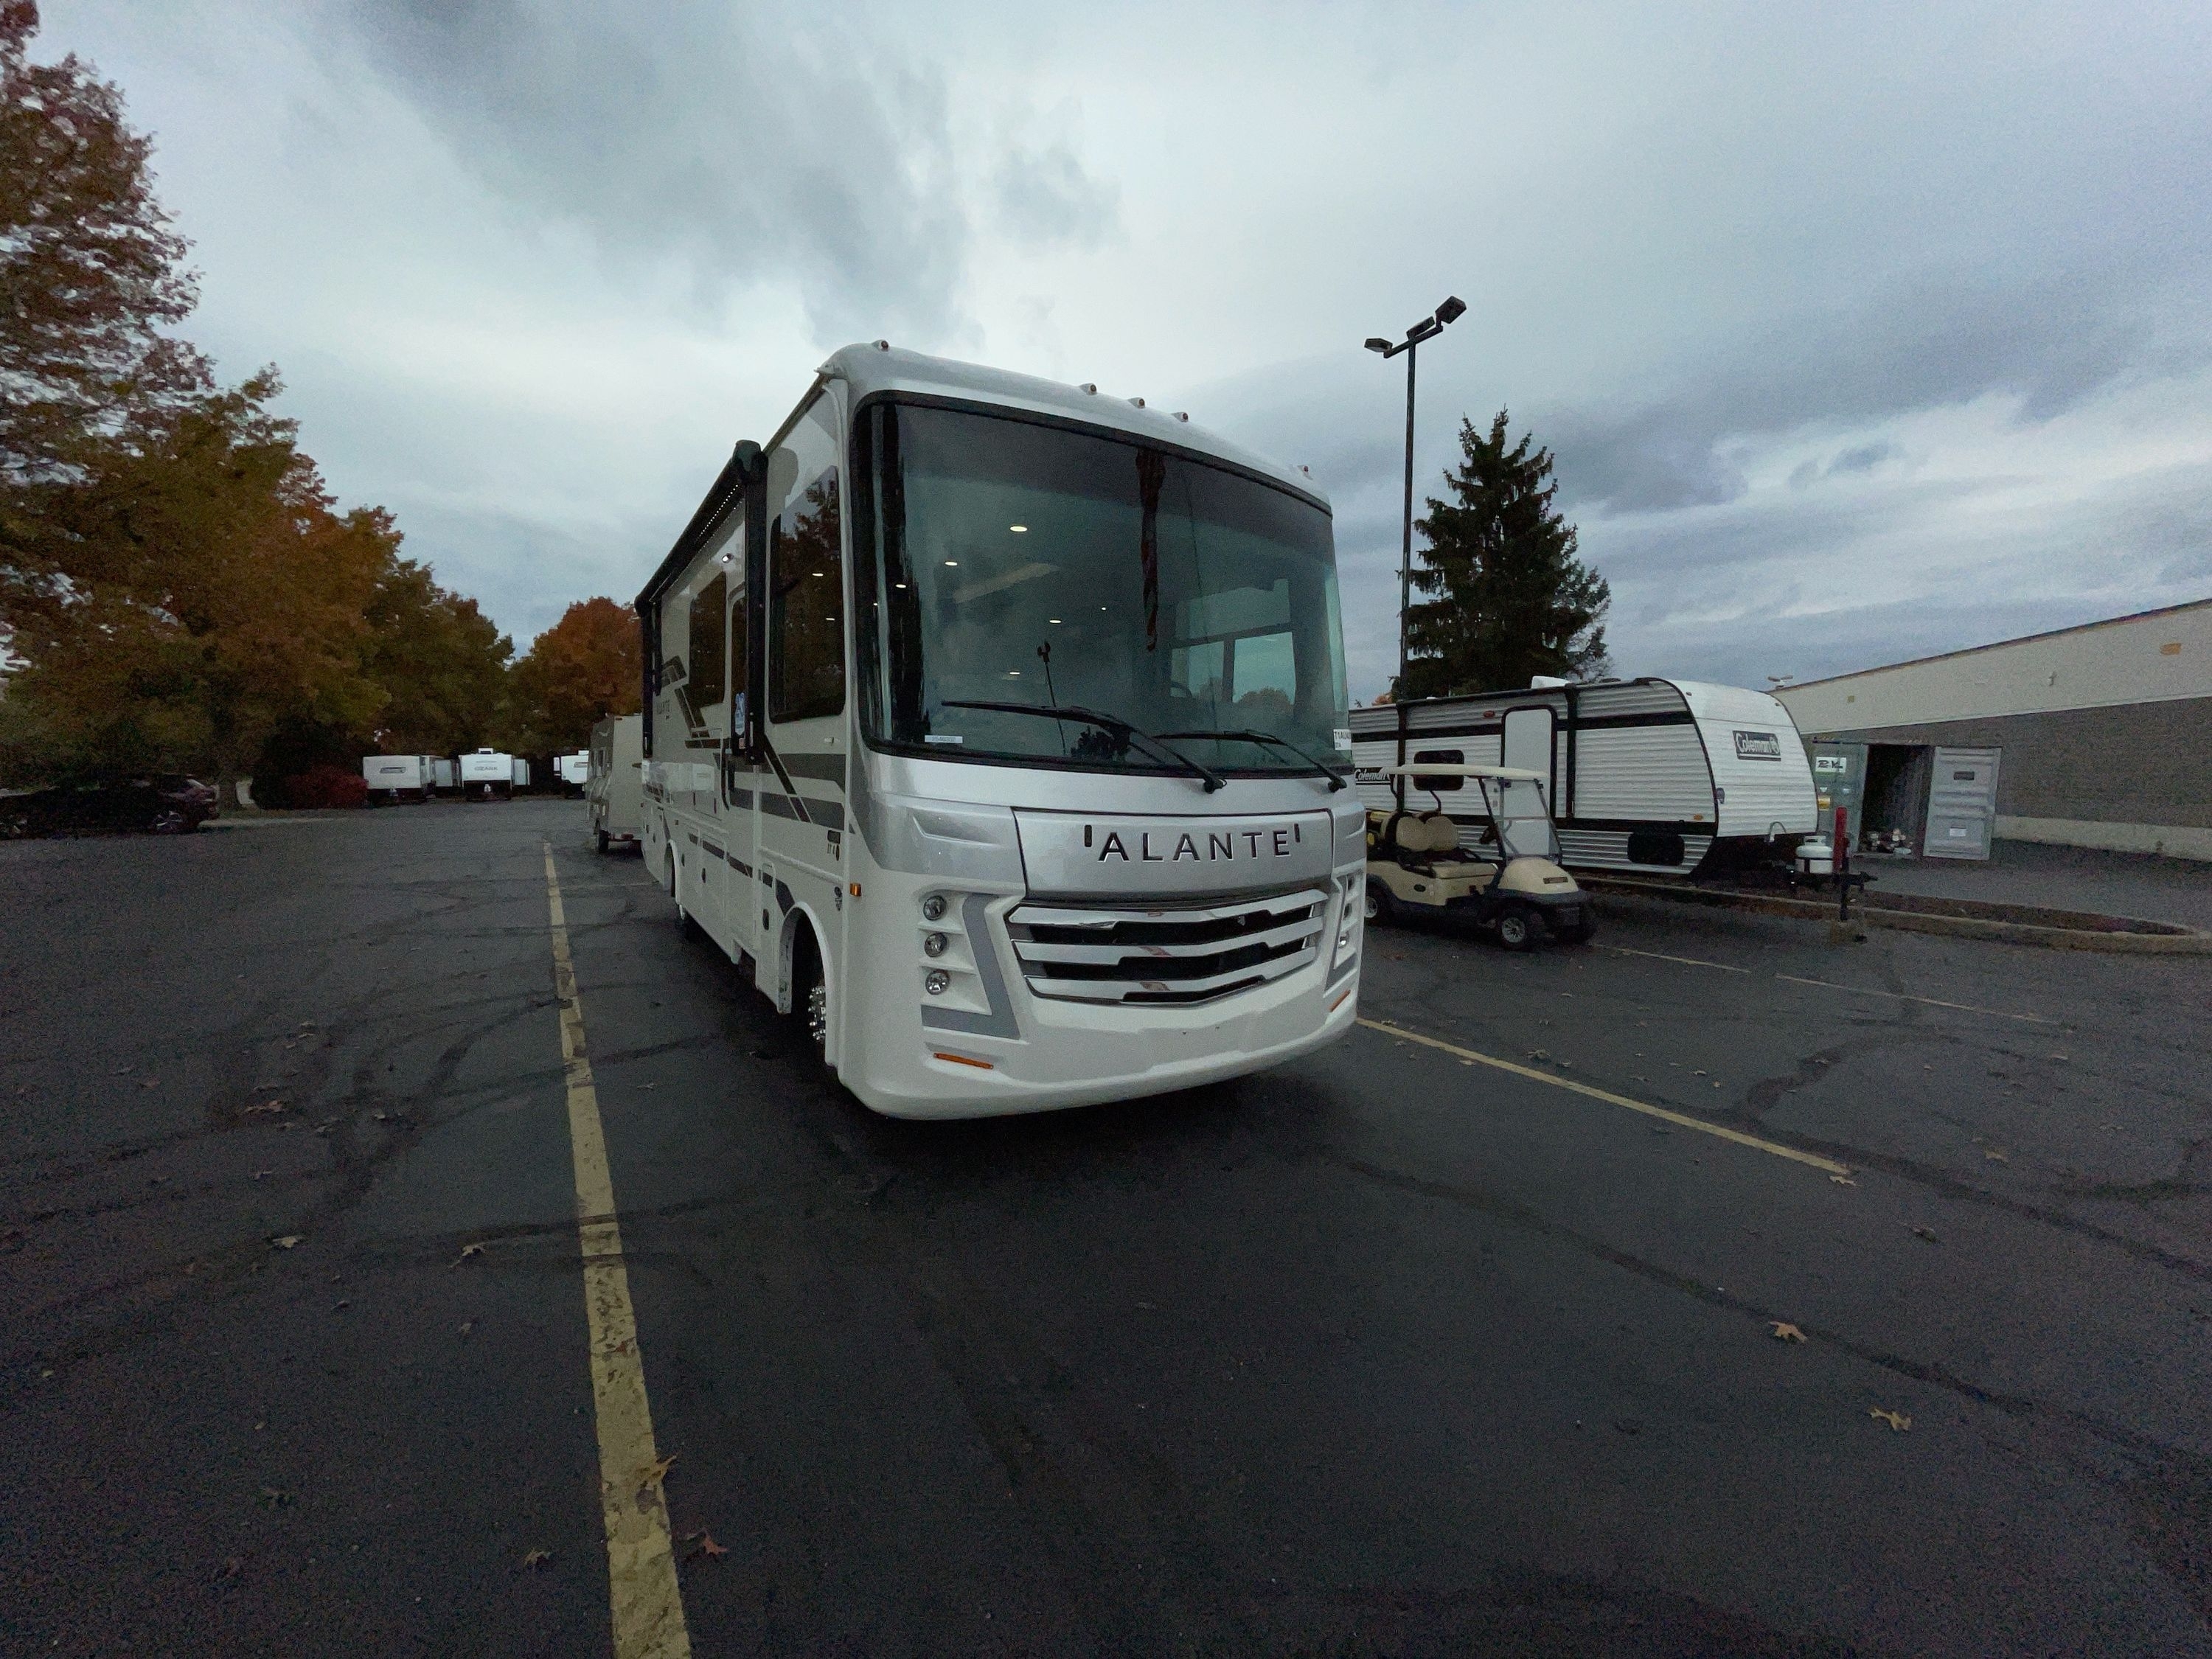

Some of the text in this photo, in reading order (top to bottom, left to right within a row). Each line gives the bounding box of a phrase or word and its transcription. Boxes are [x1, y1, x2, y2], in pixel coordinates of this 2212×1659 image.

[1736, 732, 1771, 753] Coleman
[1354, 768, 1386, 781] Coleman
[1098, 830, 1291, 862] ALANTE
